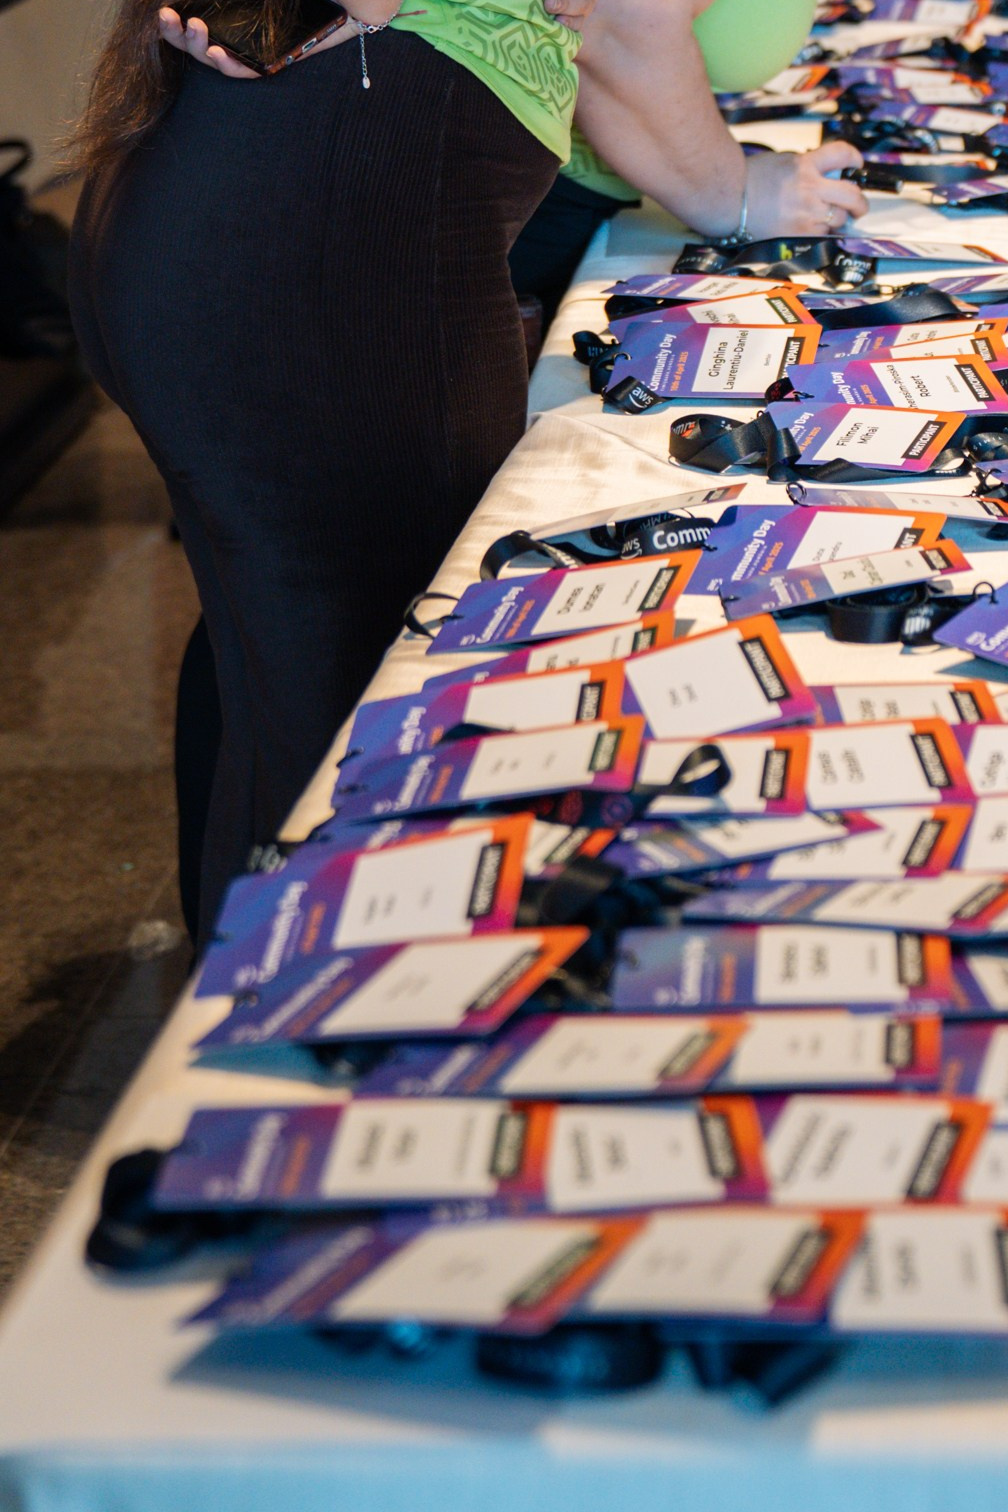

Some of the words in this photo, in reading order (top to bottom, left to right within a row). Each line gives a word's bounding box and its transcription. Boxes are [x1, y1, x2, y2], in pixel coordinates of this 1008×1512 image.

[663, 333, 677, 349] Day
[709, 341, 729, 377] Ginghina
[723, 329, 750, 390] Laurentiu-Daniel
[830, 371, 845, 385] Day
[886, 364, 918, 409] herasim-Piroska
[911, 375, 931, 397] Robert
[961, 367, 990, 399] PARTICIPANT
[632, 385, 653, 406] aws
[794, 412, 814, 426] Day
[836, 421, 863, 447] Filimon
[857, 425, 879, 445] Mihai
[909, 424, 941, 457] PARTICIPANT
[753, 520, 776, 538] Day
